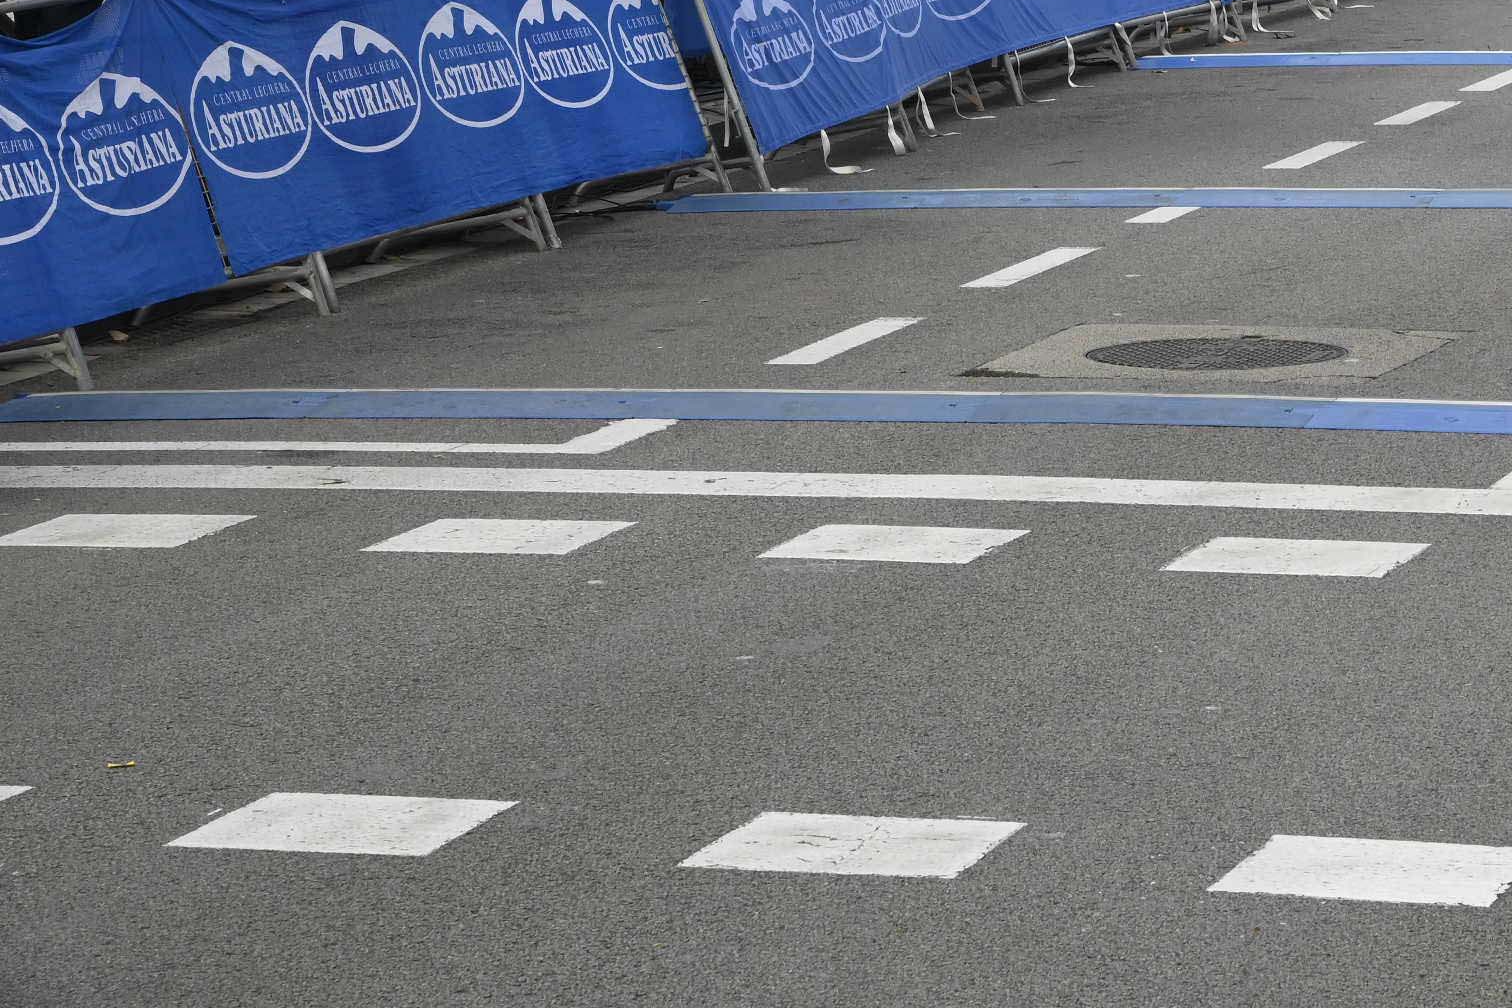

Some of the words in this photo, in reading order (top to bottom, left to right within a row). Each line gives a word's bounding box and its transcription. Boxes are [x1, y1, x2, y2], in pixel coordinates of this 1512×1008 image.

[524, 37, 609, 84] ASTURIANA
[618, 22, 676, 66] ASTUR
[213, 88, 250, 107] CENTRAL
[318, 77, 416, 126] ASTURIANA
[428, 53, 520, 102] ASTURIANA
[201, 99, 305, 152] ASTURIANA
[69, 128, 183, 188] ASTURIANA
